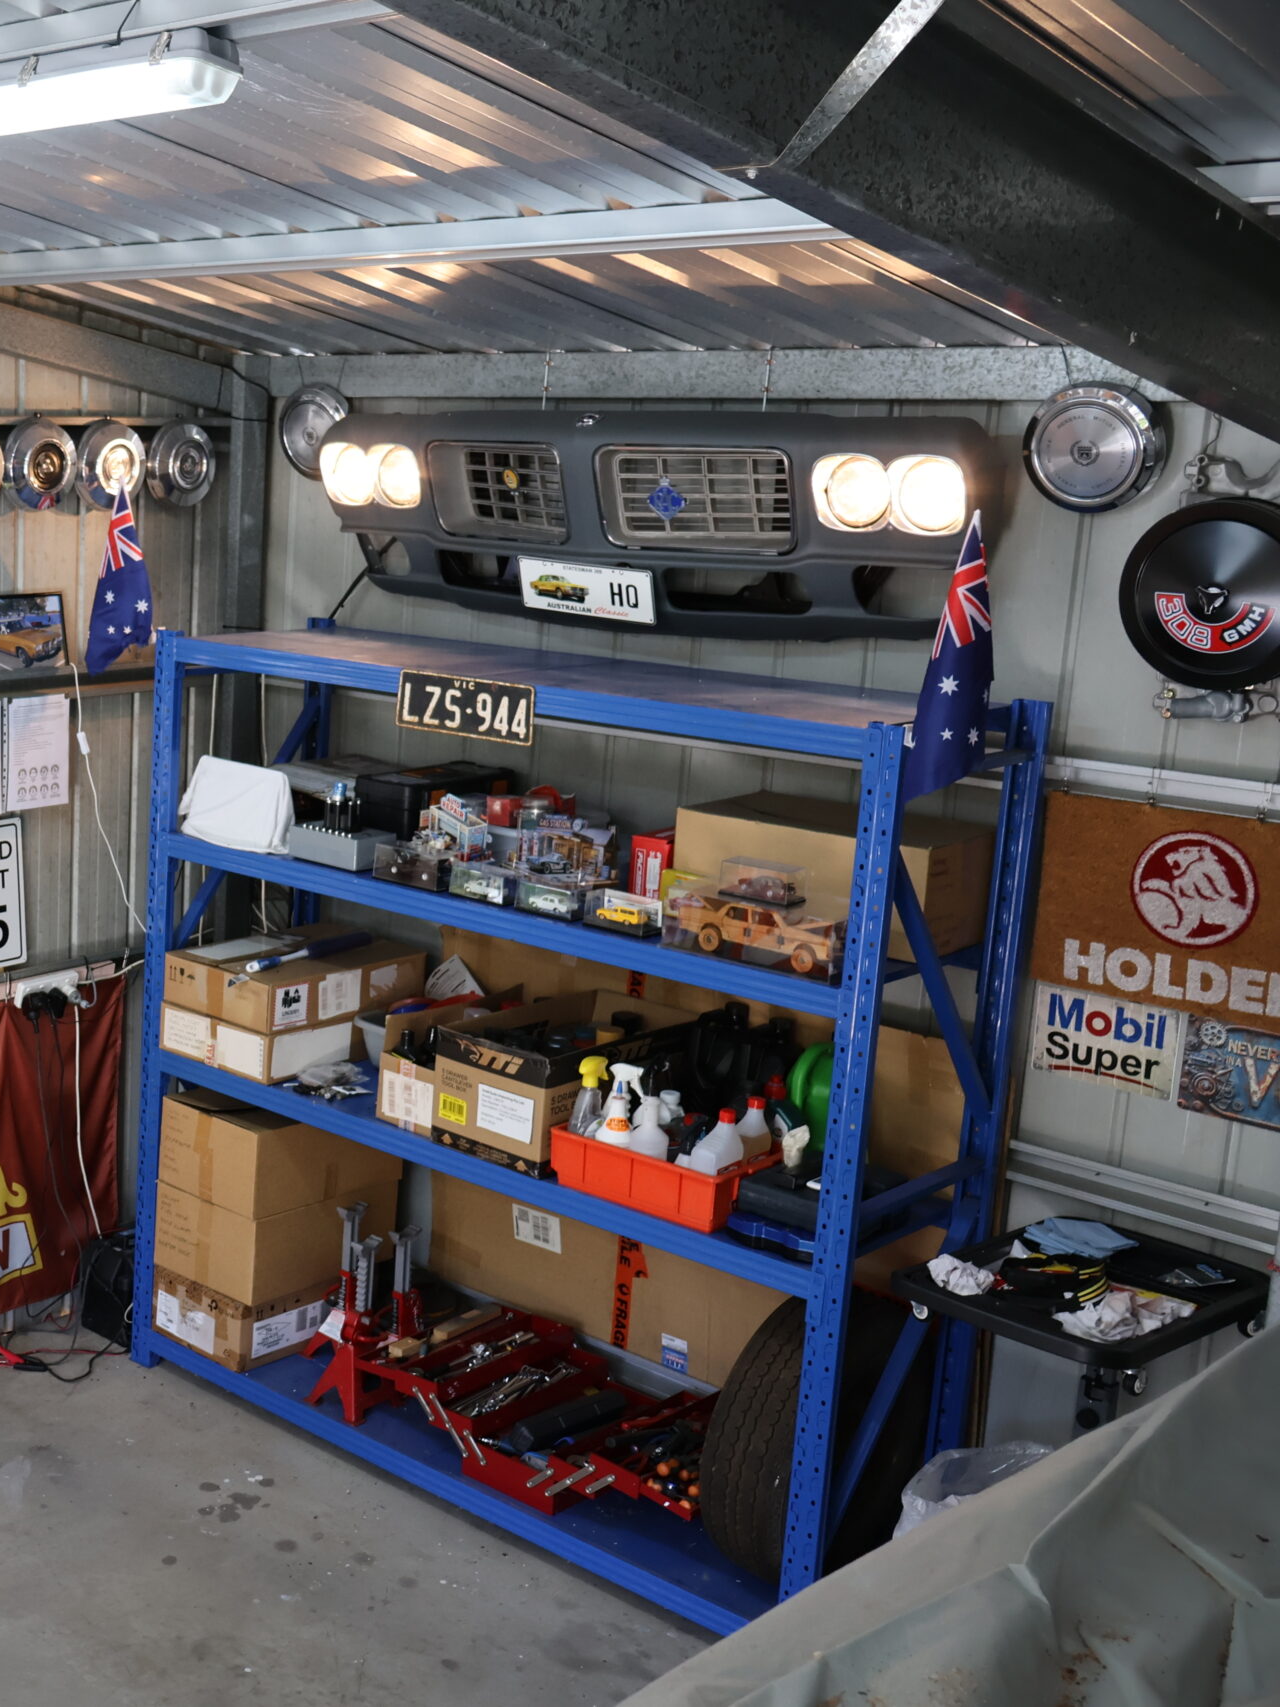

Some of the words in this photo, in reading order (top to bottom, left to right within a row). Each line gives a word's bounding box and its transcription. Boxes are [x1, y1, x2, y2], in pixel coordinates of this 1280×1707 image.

[609, 582, 639, 608] HQ
[547, 602, 592, 614] AUSTRALIAN
[593, 606, 630, 618] Classic
[1158, 596, 1212, 649] 308
[1223, 604, 1266, 643] GMH
[454, 680, 476, 690] VIC
[441, 801, 466, 820] REPAIR
[1047, 993, 1167, 1050] Mobil
[1045, 1031, 1161, 1080] Super
[550, 1104, 570, 1116] TOOL
